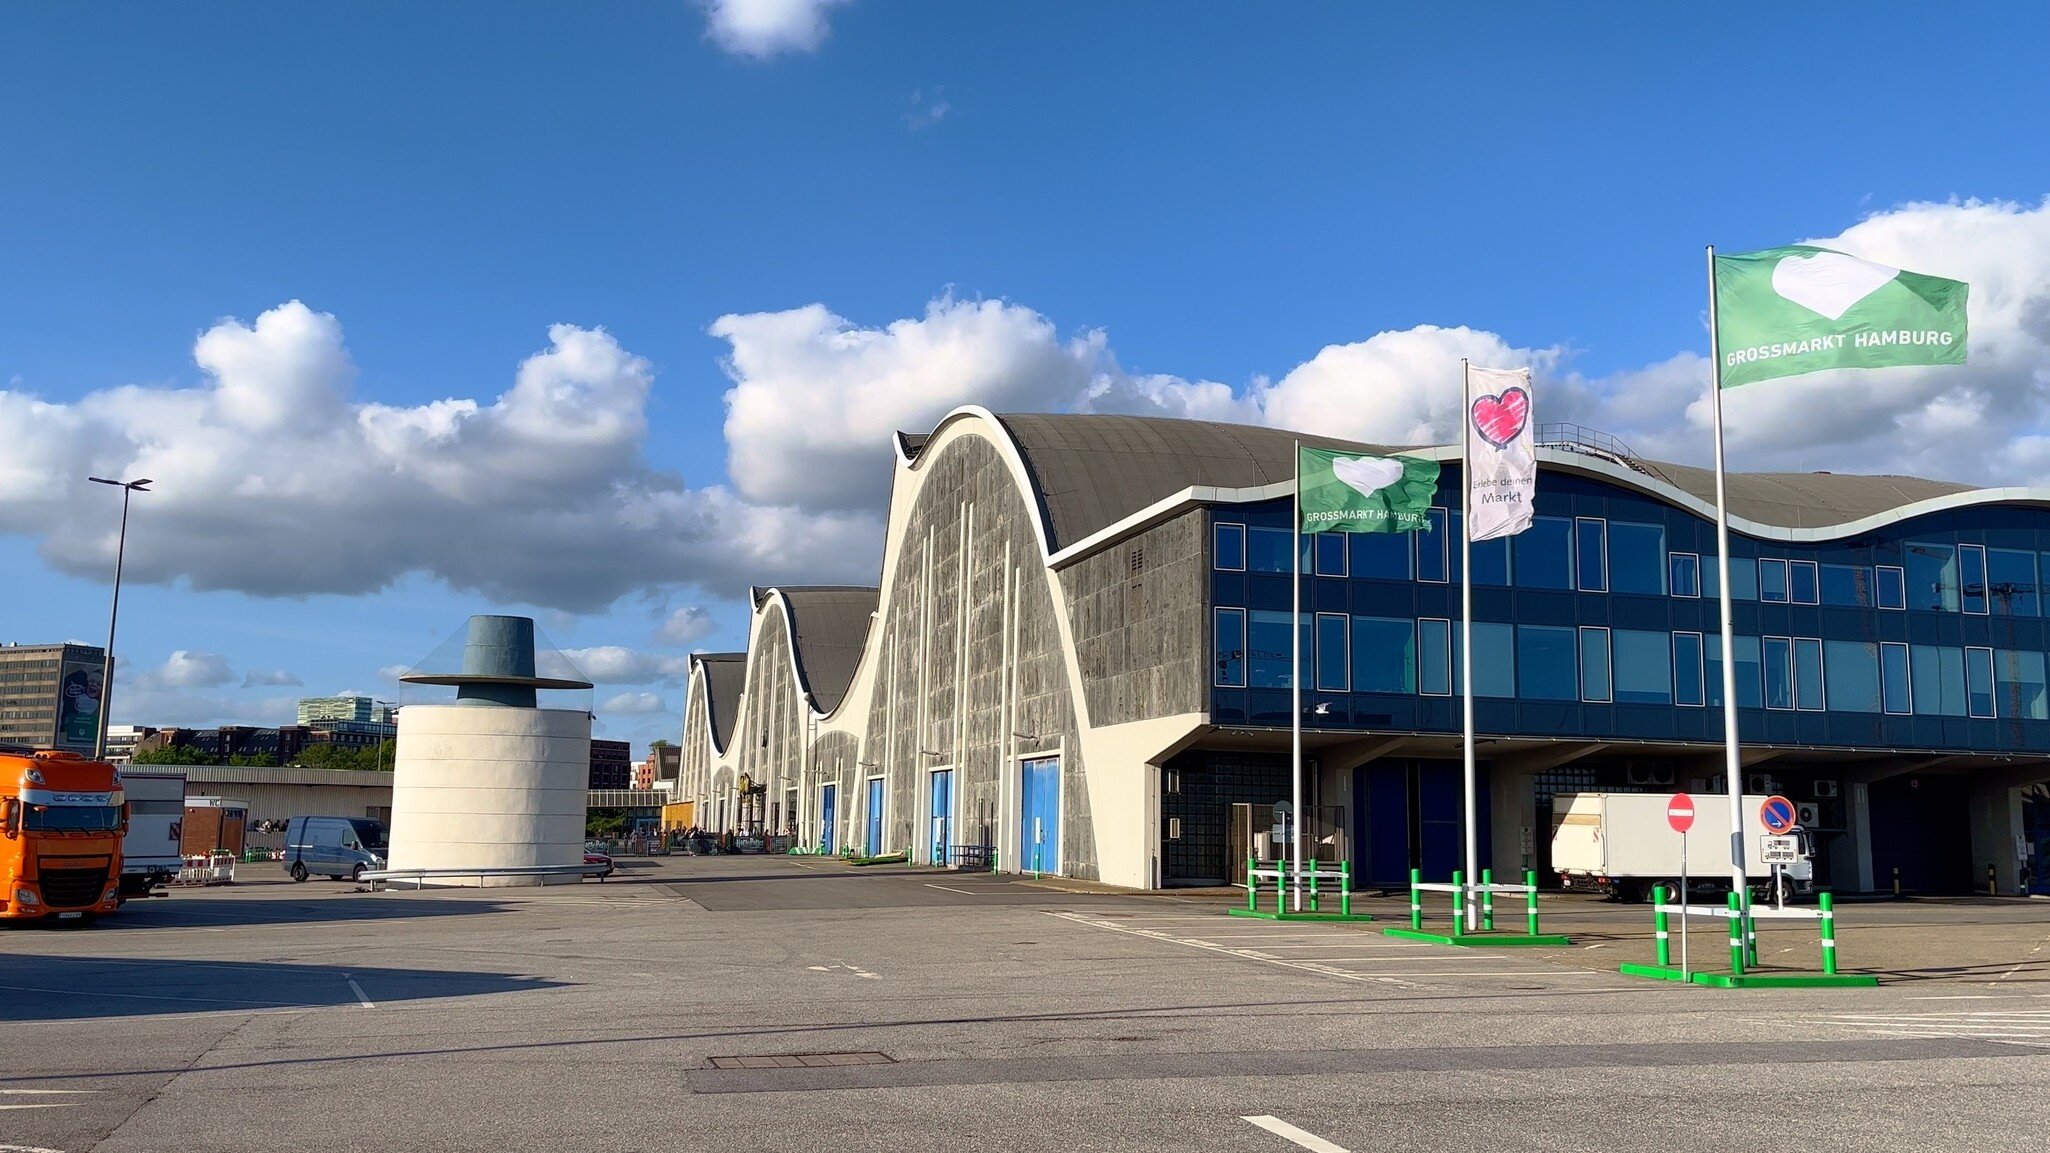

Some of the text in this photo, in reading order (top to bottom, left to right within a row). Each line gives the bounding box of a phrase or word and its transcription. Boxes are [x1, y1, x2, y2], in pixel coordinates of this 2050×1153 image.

[1726, 330, 1953, 367] GROSSMARKT HAMBURG
[1473, 477, 1533, 489] Erlebe deinen
[1481, 491, 1522, 505] Markt
[1306, 509, 1374, 522] GROSSMARKT
